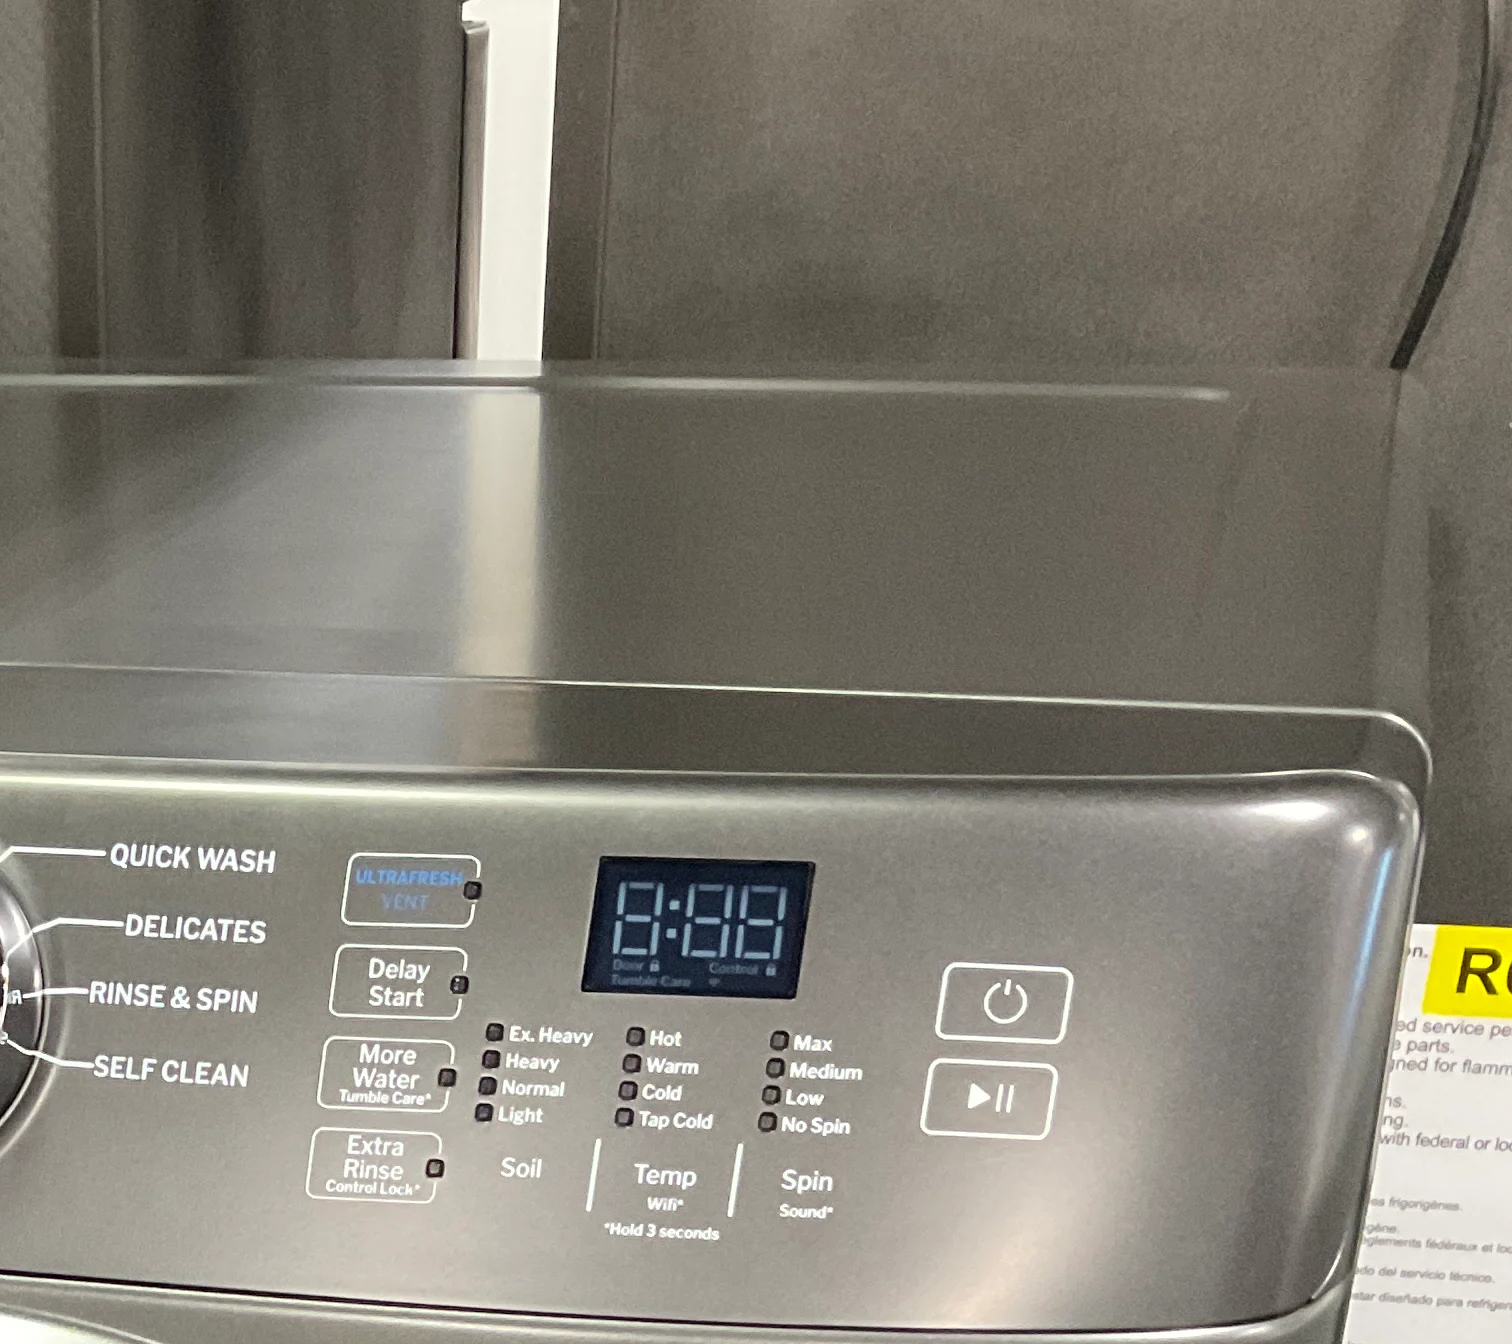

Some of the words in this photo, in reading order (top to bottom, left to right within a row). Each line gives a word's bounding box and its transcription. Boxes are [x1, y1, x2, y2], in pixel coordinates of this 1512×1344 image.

[110, 842, 192, 869] QUICK
[197, 845, 277, 873] WASH
[355, 868, 464, 887] ULTRAFRESH
[381, 893, 430, 910] VENT
[124, 912, 268, 945] DELICATES
[1407, 947, 1428, 958] n.
[368, 957, 431, 983] Delay
[1455, 947, 1512, 995] R
[89, 980, 167, 1009] RINSE
[170, 985, 191, 1010] &
[196, 987, 258, 1014] SPIN
[368, 985, 425, 1008] Start
[509, 1025, 535, 1042] Ex.
[538, 1026, 594, 1047] Heavy
[1422, 1020, 1485, 1036] service
[649, 1030, 682, 1047] Hot
[793, 1034, 833, 1052] Max
[1406, 1039, 1455, 1055] parts.
[359, 1043, 417, 1065] More
[505, 1052, 560, 1073] Heavy
[93, 1054, 158, 1081] SELF
[161, 1059, 250, 1088] CLEAN
[646, 1057, 699, 1075] Warm
[789, 1062, 863, 1081] Medium
[1434, 1057, 1458, 1073] for
[353, 1067, 420, 1090] Water
[502, 1079, 565, 1097] Normal
[339, 1089, 389, 1104] Tumble
[641, 1083, 682, 1101] Cold
[785, 1089, 825, 1106] Low
[498, 1106, 544, 1125] Light
[639, 1110, 670, 1130] Tap
[673, 1112, 713, 1130] Cold
[781, 1117, 807, 1133] No
[810, 1117, 851, 1136] Spin
[347, 1134, 404, 1157] Extra
[1415, 1132, 1470, 1149] federal
[1474, 1138, 1491, 1151] or
[343, 1158, 404, 1180] Rinse
[500, 1157, 543, 1178] Soil
[634, 1163, 697, 1190] Temp
[325, 1179, 377, 1194] Control
[781, 1168, 833, 1194] Spin
[646, 1224, 656, 1237] 3
[659, 1226, 720, 1241] seconds
